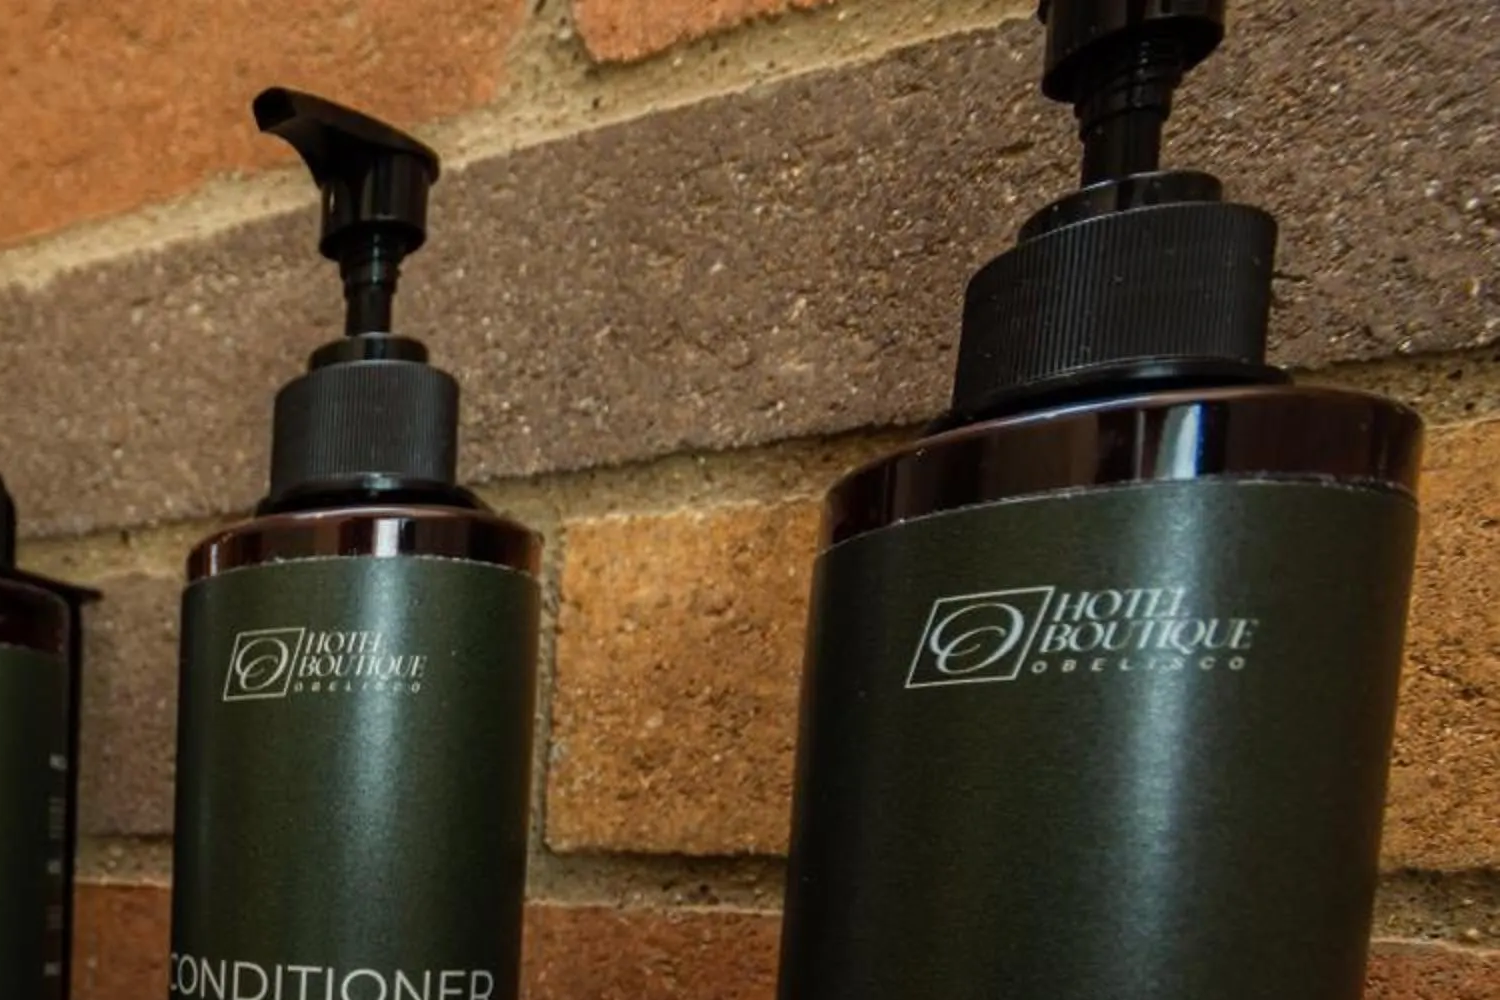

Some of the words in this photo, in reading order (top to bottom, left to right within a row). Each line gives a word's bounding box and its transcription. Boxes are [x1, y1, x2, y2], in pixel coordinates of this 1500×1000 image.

[1053, 585, 1190, 622] HOTEL
[1039, 617, 1260, 655] BOUTIQUE
[298, 654, 428, 680] BOUTIQUE
